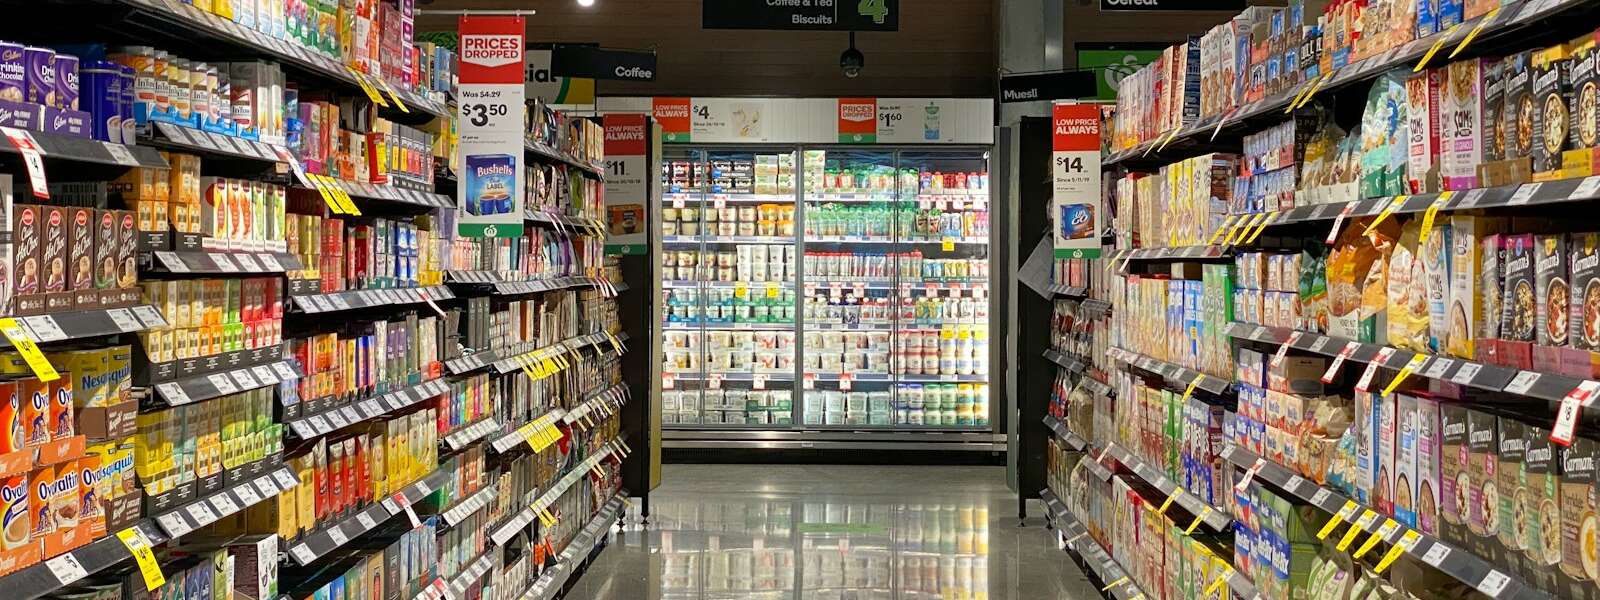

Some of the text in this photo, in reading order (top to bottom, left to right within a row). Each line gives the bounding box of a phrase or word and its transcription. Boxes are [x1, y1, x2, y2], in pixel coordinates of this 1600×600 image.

[858, 0, 888, 24] 4
[791, 14, 833, 24] Biscuits
[465, 38, 519, 50] PRICES
[465, 50, 519, 59] DROPPED
[615, 66, 652, 79] Coffee
[1004, 89, 1038, 100] Muesli
[693, 105, 709, 119] $4
[1075, 118, 1098, 126] PRICE
[605, 132, 644, 141] ALWAYS
[1056, 126, 1098, 135] ALWAYS
[477, 164, 513, 177] Bushells
[606, 160, 626, 176] $11
[1056, 156, 1083, 173] $14
